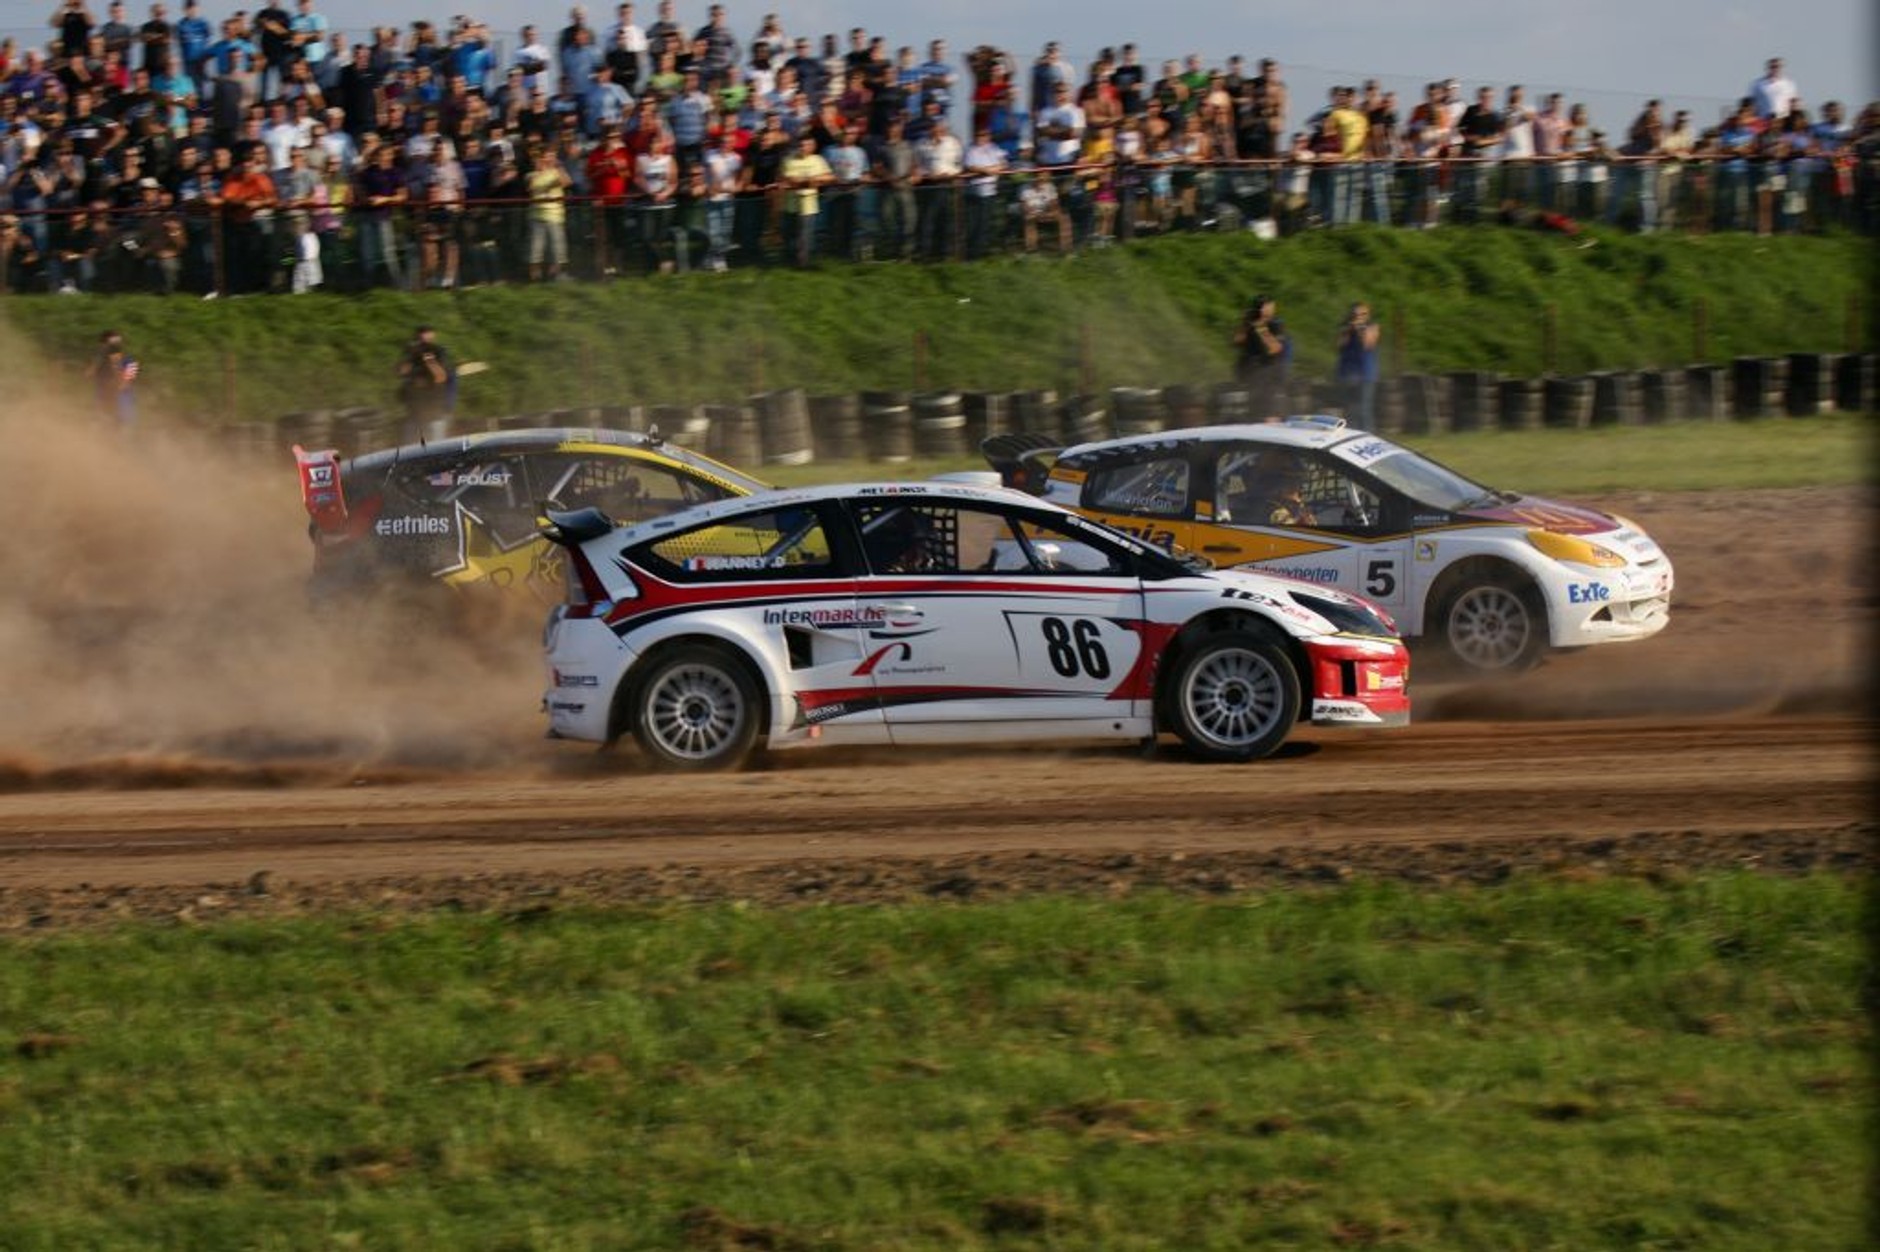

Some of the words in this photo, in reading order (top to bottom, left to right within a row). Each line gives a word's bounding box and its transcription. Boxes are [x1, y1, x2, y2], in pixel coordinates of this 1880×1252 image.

[392, 514, 450, 535] etnies
[1366, 560, 1396, 597] 5
[1567, 582, 1610, 604] ExTe
[1041, 616, 1111, 680] 86
